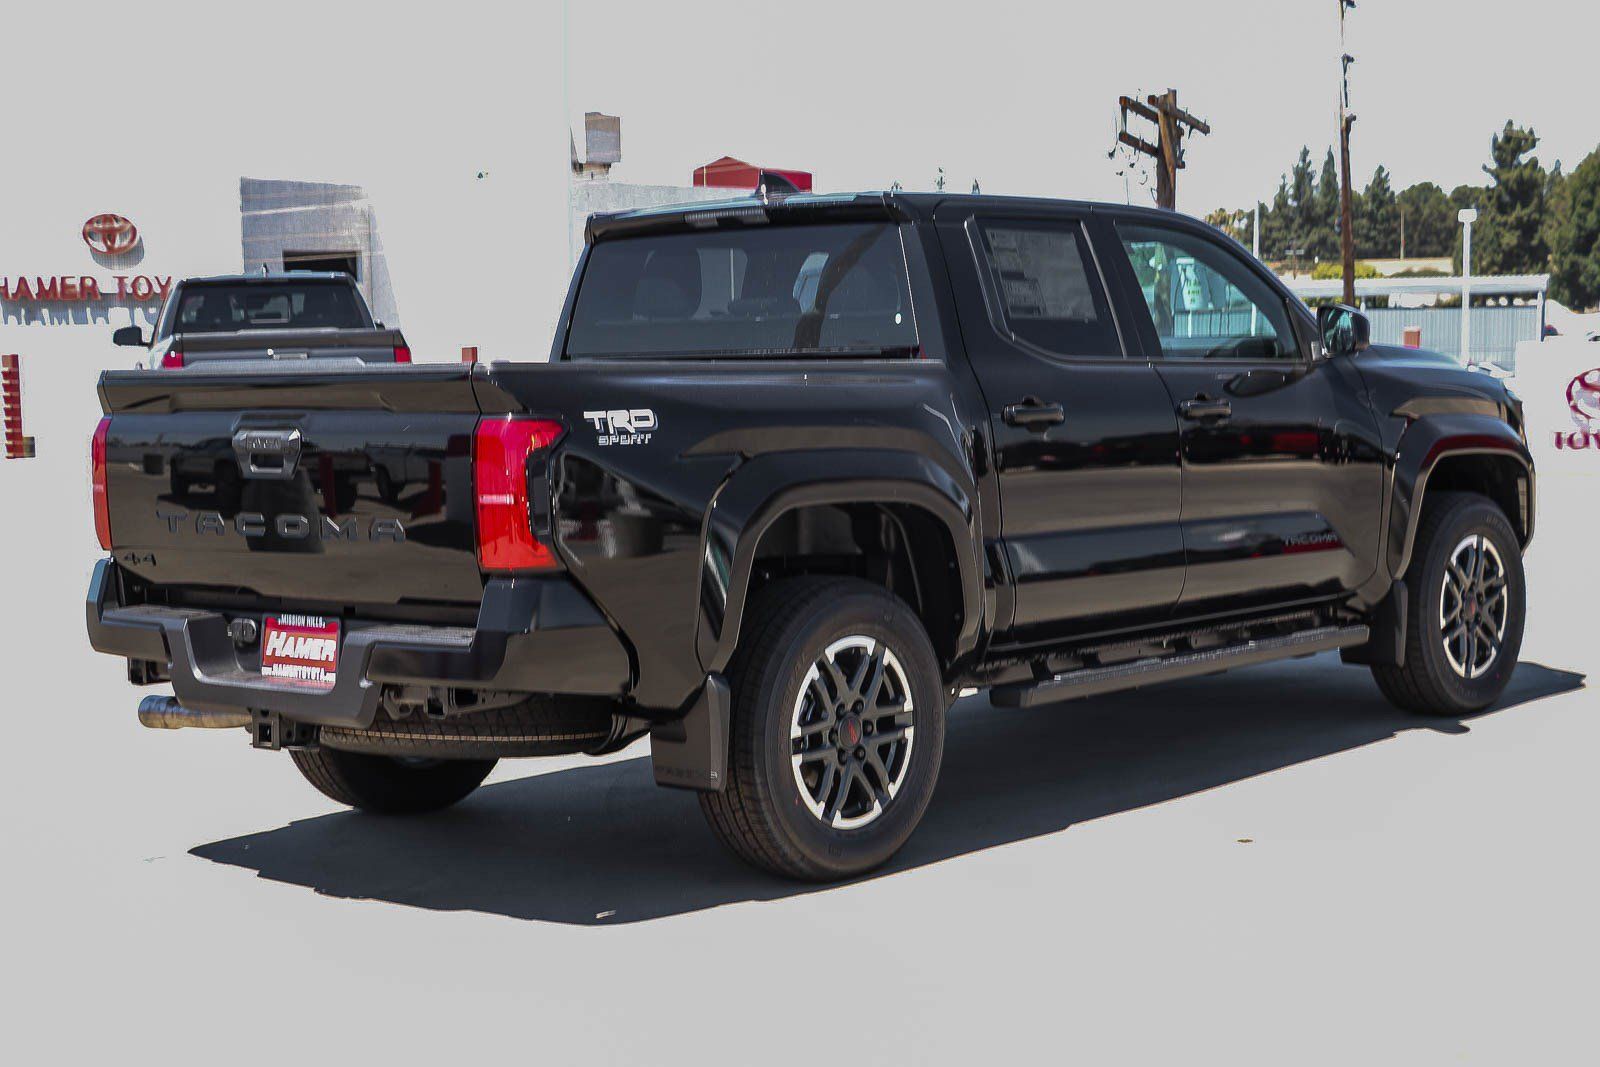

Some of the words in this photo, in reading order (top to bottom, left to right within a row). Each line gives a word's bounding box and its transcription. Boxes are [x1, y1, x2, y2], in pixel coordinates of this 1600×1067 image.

[583, 409, 658, 434] TRD
[598, 433, 652, 446] SPORT
[155, 507, 407, 543] TACOMA
[280, 613, 306, 628] MISSION
[265, 630, 337, 662] HAMER
